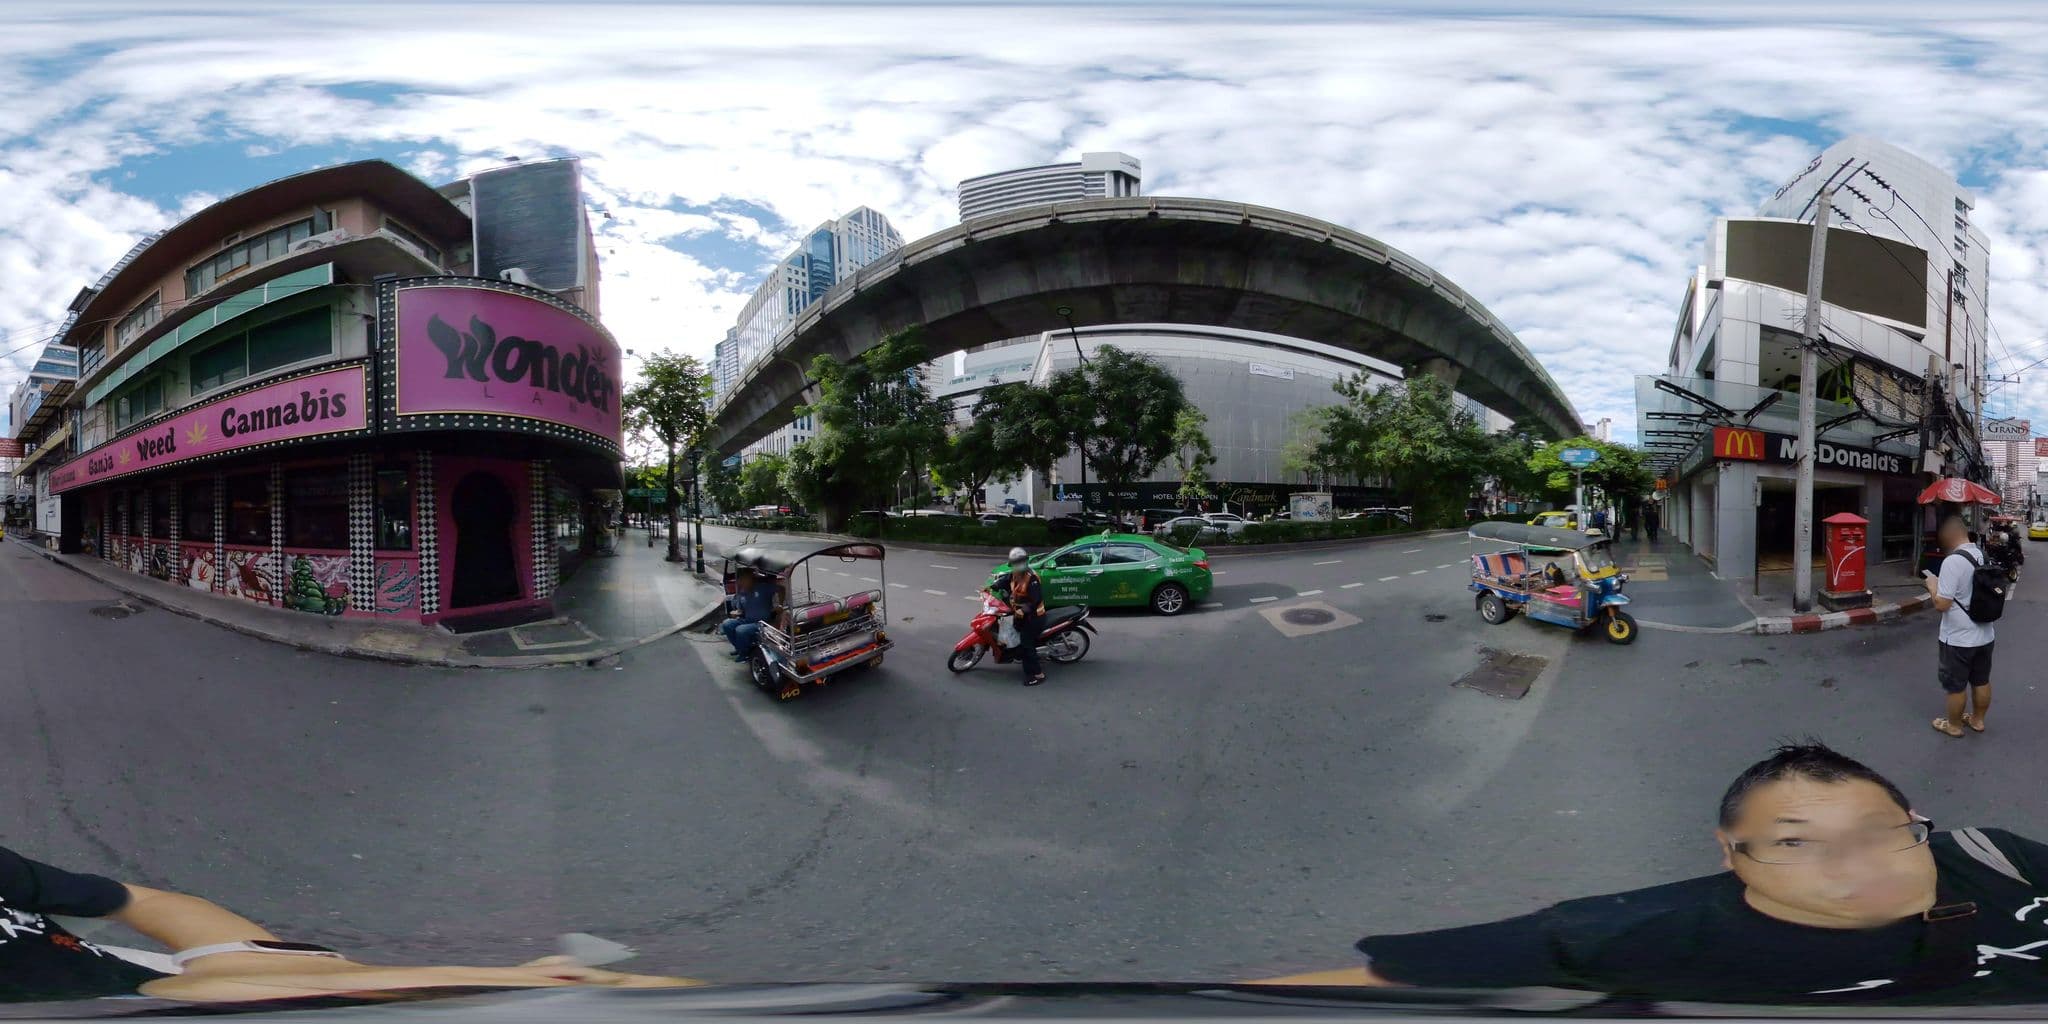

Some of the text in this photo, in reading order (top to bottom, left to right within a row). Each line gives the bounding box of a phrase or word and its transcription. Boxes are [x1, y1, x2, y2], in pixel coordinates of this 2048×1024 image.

[427, 314, 613, 413] Wonder
[89, 389, 346, 475] Ganja Weed Cannabis
